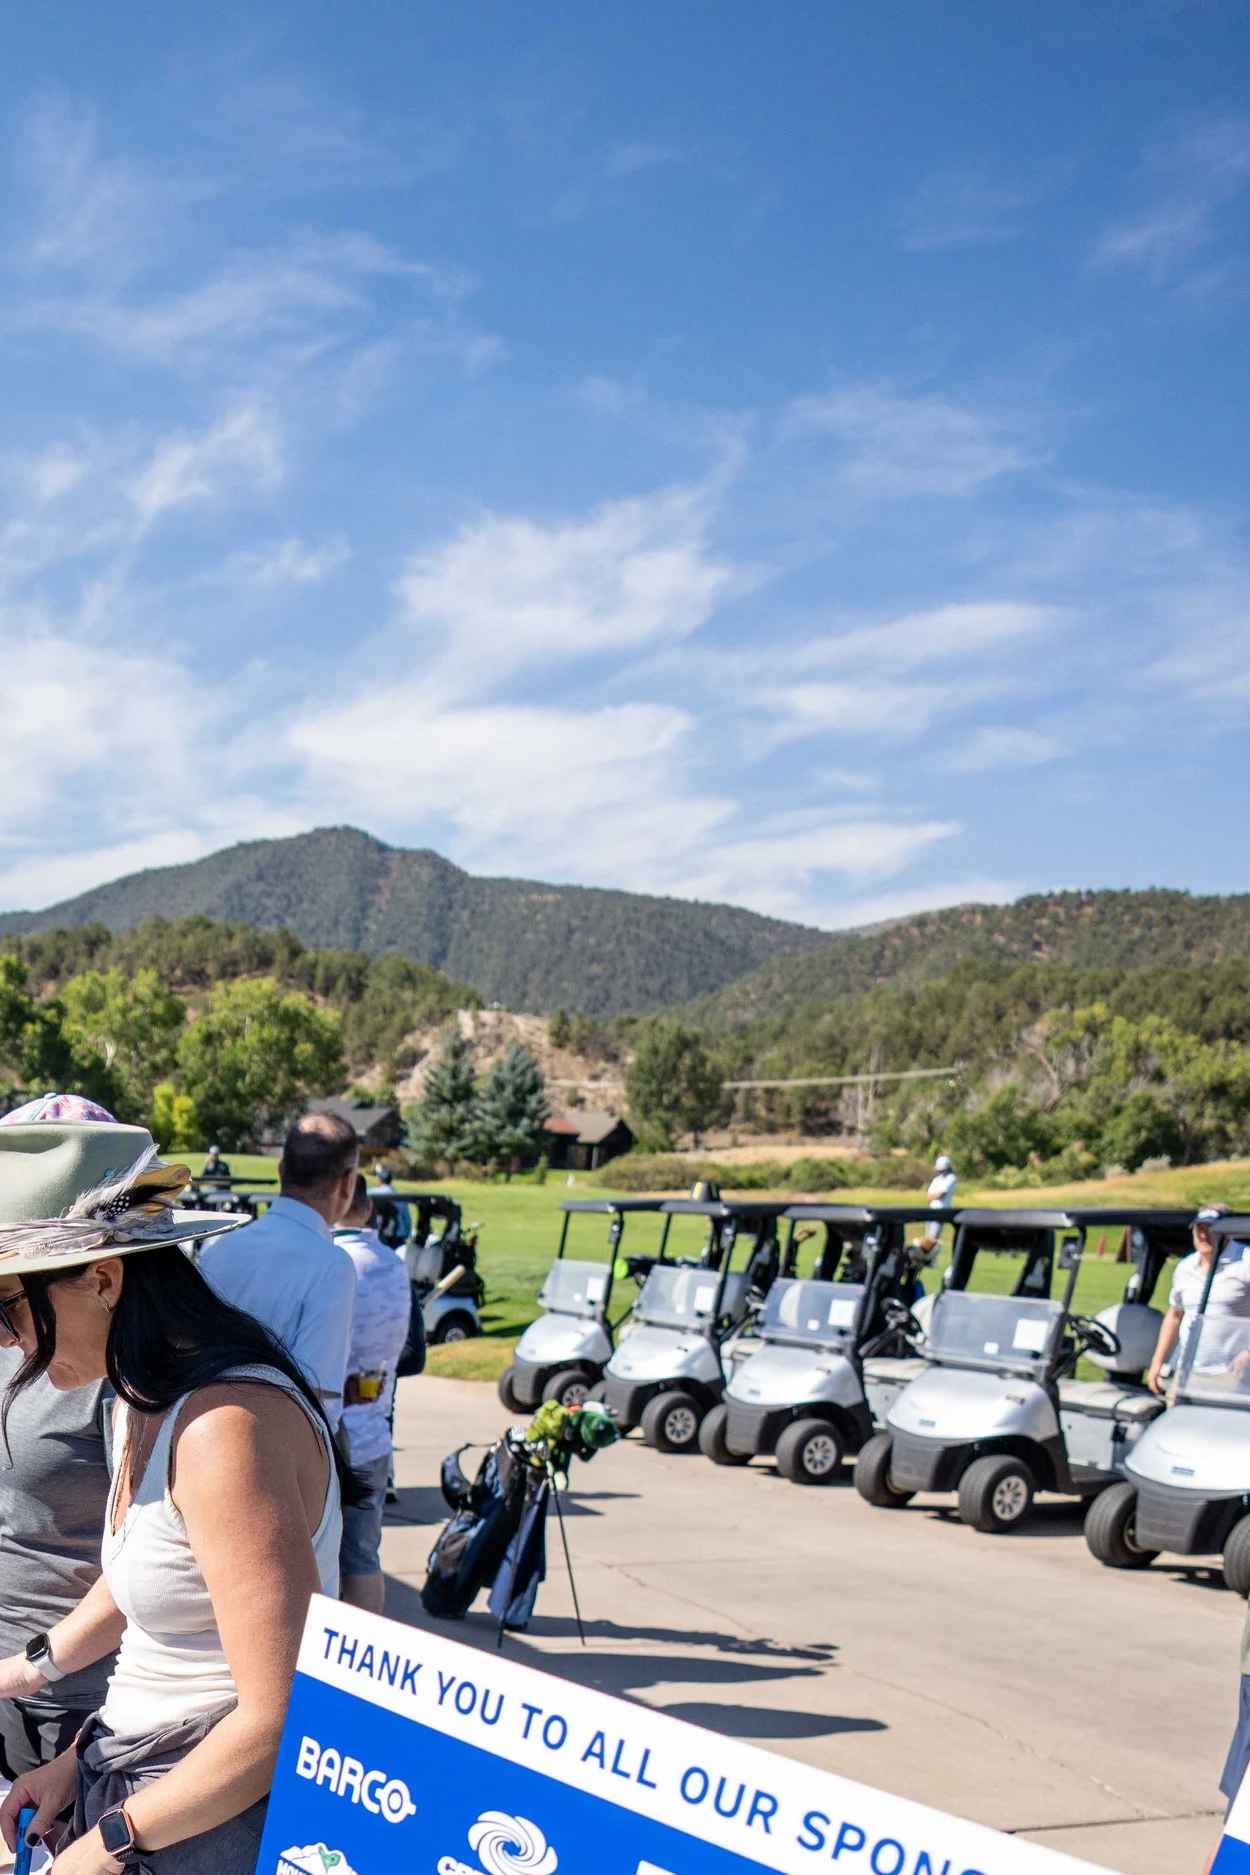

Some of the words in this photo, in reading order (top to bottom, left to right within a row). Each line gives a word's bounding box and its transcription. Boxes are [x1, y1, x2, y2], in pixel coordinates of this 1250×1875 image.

[296, 1736, 417, 1824] BARCO
[323, 1627, 423, 1696] THANK
[437, 1671, 505, 1726] YOU
[521, 1703, 568, 1750] TO
[581, 1731, 657, 1789] ALL
[680, 1766, 779, 1834] OUR
